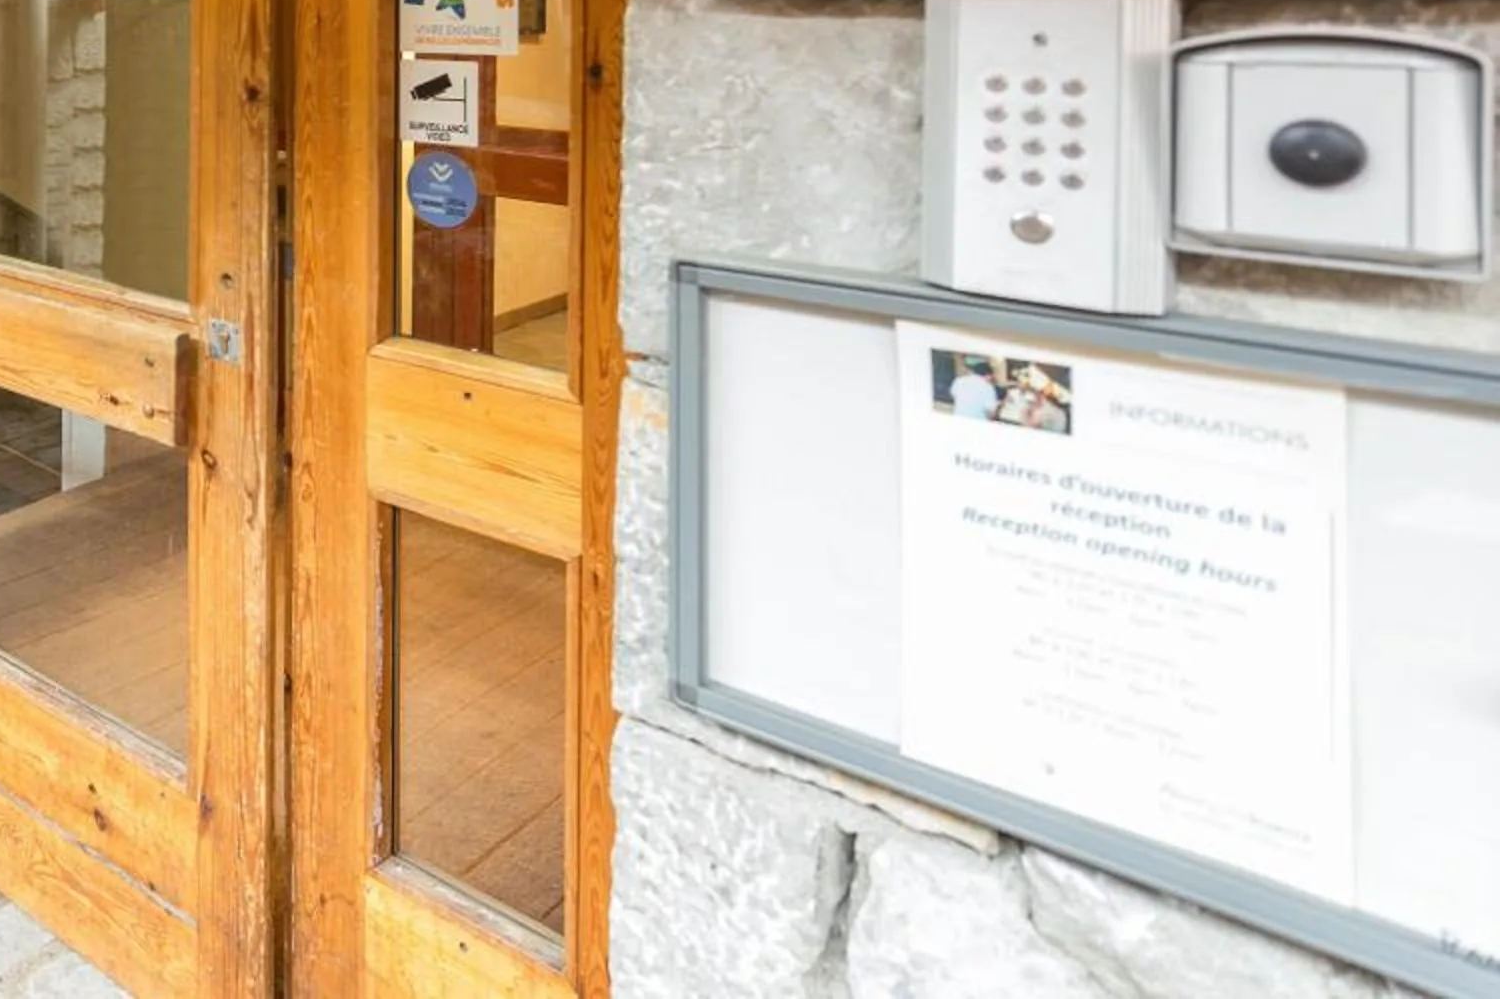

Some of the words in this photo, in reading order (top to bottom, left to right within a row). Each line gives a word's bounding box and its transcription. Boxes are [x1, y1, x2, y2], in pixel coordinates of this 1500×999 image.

[1110, 401, 1310, 451] INFORMATIONS
[954, 452, 1051, 486] Horaires
[1059, 473, 1209, 519] d'ouverture
[1218, 504, 1252, 528] de
[1262, 511, 1287, 535] la
[1051, 499, 1171, 541] réception
[963, 506, 1077, 547] Reception
[1086, 536, 1191, 577] opening
[1200, 557, 1278, 594] hours
